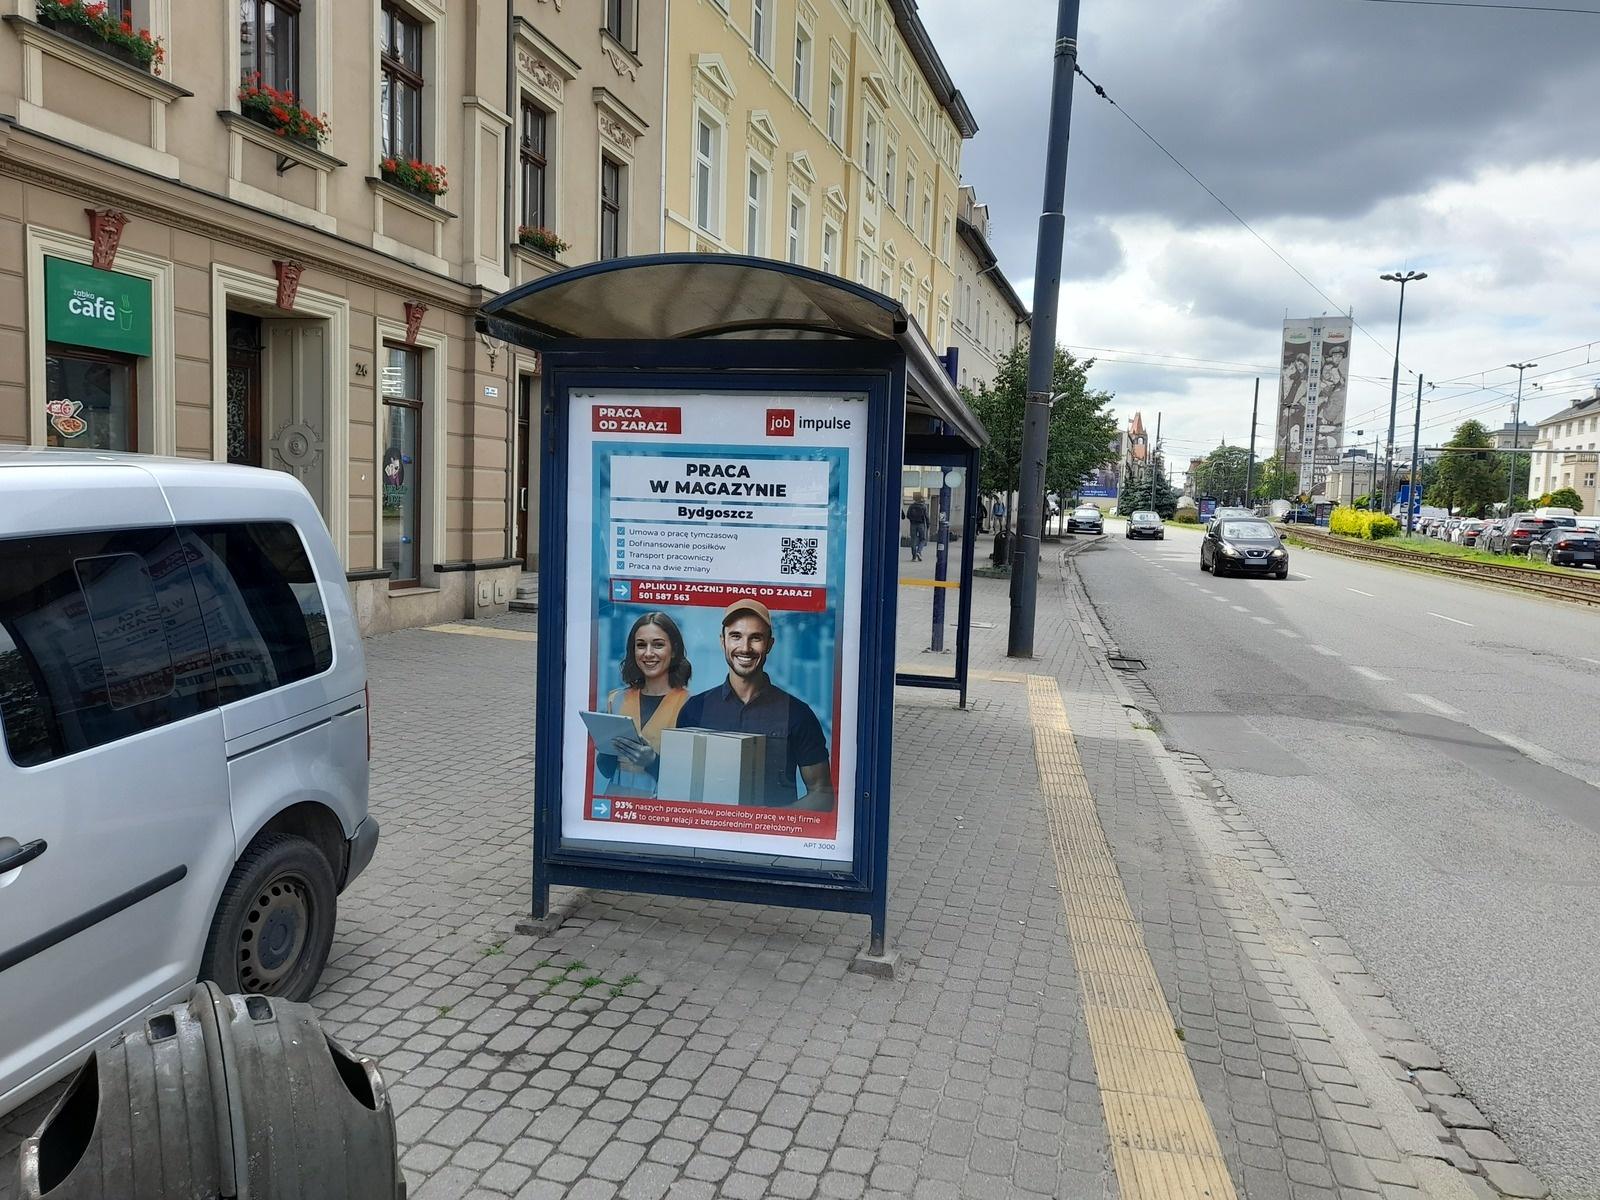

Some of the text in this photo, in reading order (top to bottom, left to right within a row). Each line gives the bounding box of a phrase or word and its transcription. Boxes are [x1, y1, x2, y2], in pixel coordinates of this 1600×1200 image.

[355, 362, 368, 377] 26
[599, 407, 642, 418] PRACA
[599, 420, 668, 431] OD ZARAZ!
[770, 415, 851, 432] job impulse
[686, 463, 751, 479] PRACA
[649, 480, 787, 497] W MAGAZYNIE
[678, 506, 754, 520] Bydgoszcz
[629, 528, 659, 537] Umowa
[667, 530, 689, 539] pracę
[690, 531, 739, 540] tymczasową
[629, 540, 727, 551] Dofinansowanie posiłków
[629, 551, 714, 564] Transport pracowniczy
[629, 562, 650, 571] Praca
[662, 564, 682, 572] dwie
[683, 565, 711, 575] zmiany
[639, 582, 677, 591] APLIKUJ
[684, 584, 724, 593] ZACZNIJ
[726, 586, 758, 597] PRACĘ
[759, 588, 774, 596] OD
[776, 589, 812, 597] ZARAZ!
[673, 593, 690, 601] 563
[614, 800, 633, 810] 93%
[635, 804, 664, 813] naszych
[665, 805, 715, 817] pracowników
[715, 809, 754, 820] poleciłoby
[755, 813, 777, 822] pracę
[798, 815, 821, 824] firmie
[614, 811, 637, 820] 4,5/5
[648, 814, 670, 823] ocena
[671, 816, 693, 826] relacji
[700, 818, 753, 829] bezpośrednim
[754, 822, 803, 834] przełożonym
